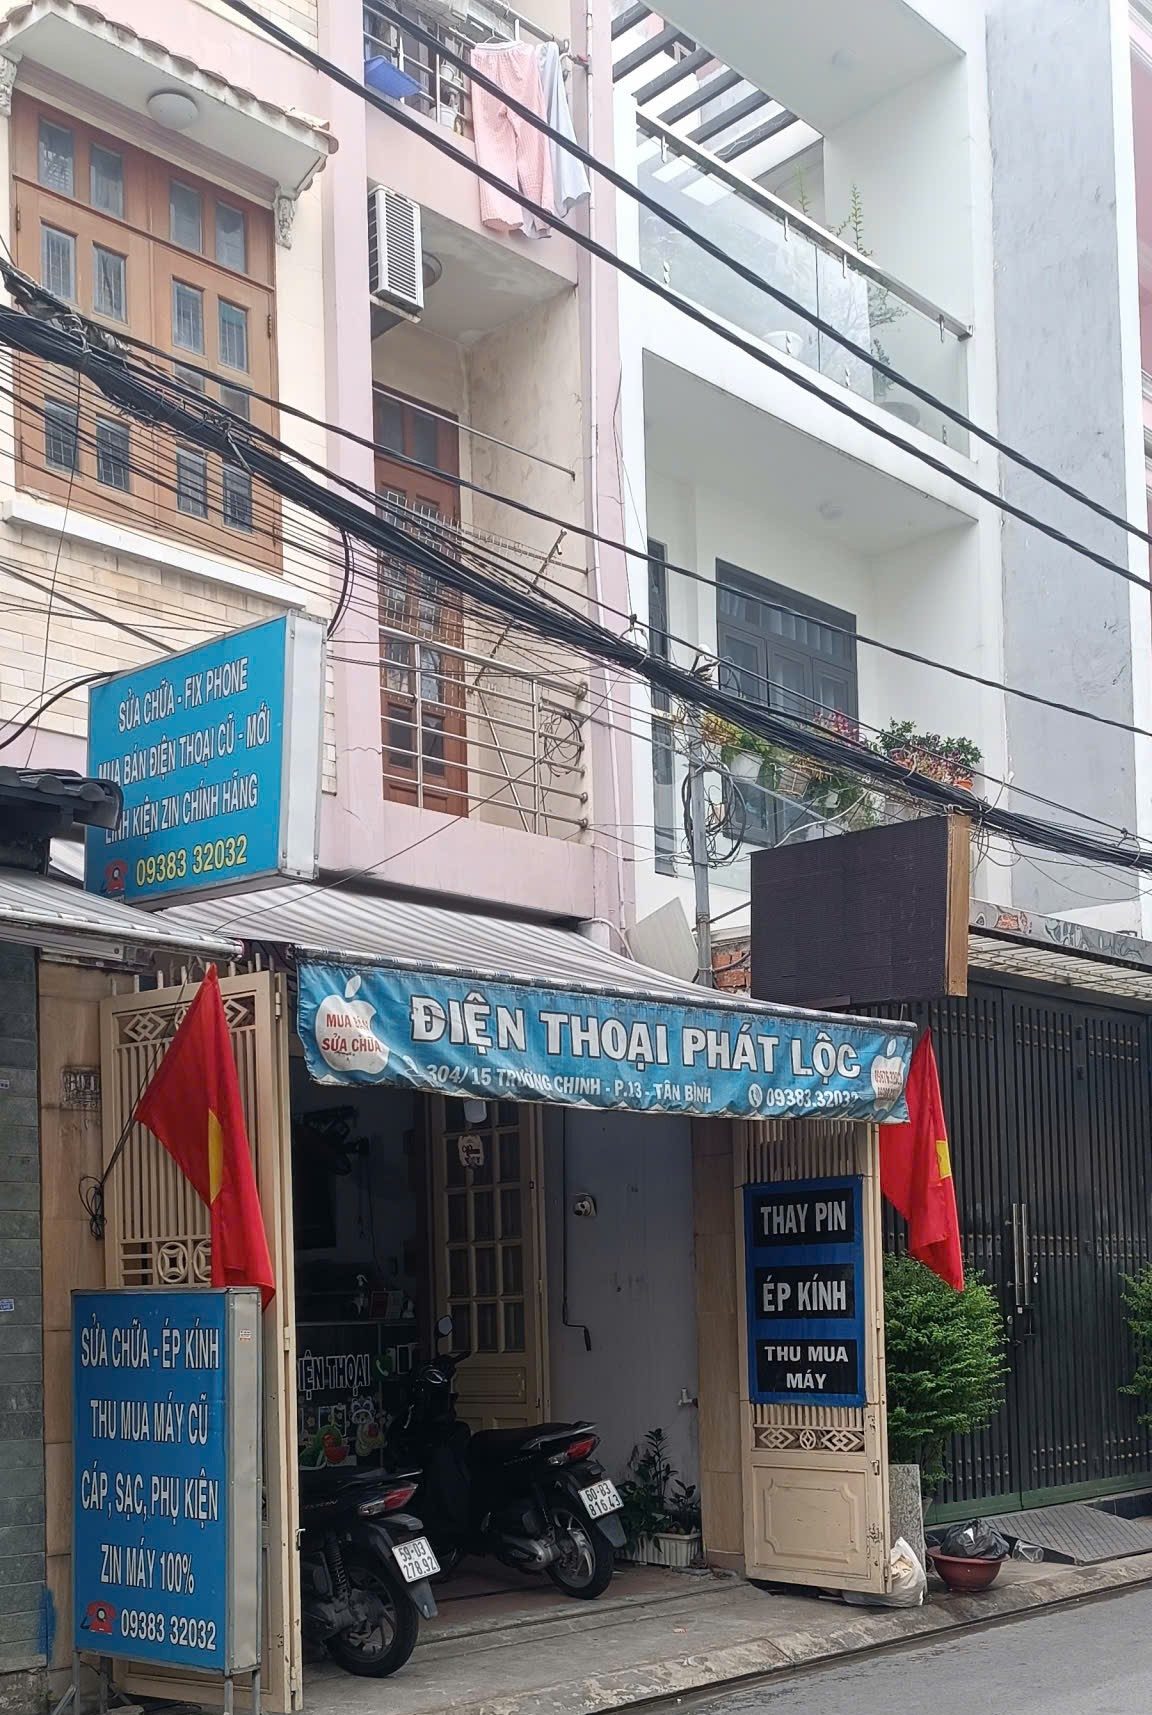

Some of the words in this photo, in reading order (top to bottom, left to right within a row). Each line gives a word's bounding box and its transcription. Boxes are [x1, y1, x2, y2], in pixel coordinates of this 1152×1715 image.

[118, 687, 141, 732] SỬA
[143, 677, 175, 724] CHỮA
[184, 673, 203, 710] FIX
[206, 656, 248, 702] PHONE
[124, 743, 147, 786] BÁN
[150, 735, 176, 780] ĐIỆN
[179, 728, 215, 768] THOẠI
[218, 712, 235, 757] CŨ
[246, 701, 271, 749] MỚI
[132, 795, 159, 842] KIỆN
[161, 795, 180, 831] ZIN
[182, 778, 219, 825] CHÍNH
[222, 768, 258, 814] HÃNG
[136, 847, 187, 887] 09383
[192, 834, 247, 874] 32032
[321, 1032, 347, 1052] SỬA
[326, 1013, 352, 1028] MUA
[409, 989, 527, 1055] ĐIỆN
[538, 1010, 669, 1072] THOẠI
[682, 1023, 779, 1073] PHÁT
[790, 1031, 862, 1085] LỘC
[554, 1071, 601, 1096] CHINH
[613, 1080, 643, 1099] P.13
[653, 1077, 681, 1102] TÂN
[684, 1081, 712, 1104] BÌNH
[760, 1203, 808, 1236] THAY
[815, 1200, 847, 1232] PIN
[762, 1274, 792, 1312] ÉP
[797, 1272, 847, 1311] KÍNH
[81, 1312, 108, 1368] SỬA
[111, 1318, 150, 1369] CHỮA
[162, 1317, 181, 1369] ÉP
[185, 1317, 219, 1369] KÍNH
[764, 1345, 801, 1362] THU
[807, 1345, 849, 1362] MUA
[297, 1349, 325, 1400] IỆN
[785, 1369, 827, 1390] MÁY
[90, 1399, 117, 1440] THU
[121, 1401, 150, 1442] MUA
[153, 1391, 184, 1443] MÁY
[188, 1392, 209, 1446] CŨ
[81, 1460, 112, 1519] CÁP,
[115, 1472, 147, 1522] SẠC,
[151, 1475, 179, 1526] PHỤ
[184, 1467, 219, 1529] KIỆN
[101, 1544, 122, 1585] ZIN
[126, 1537, 156, 1590] MÁY
[160, 1551, 195, 1595] 100%
[403, 1556, 436, 1579] 278.92
[120, 1608, 165, 1643] 09383
[169, 1615, 216, 1651] 32032
